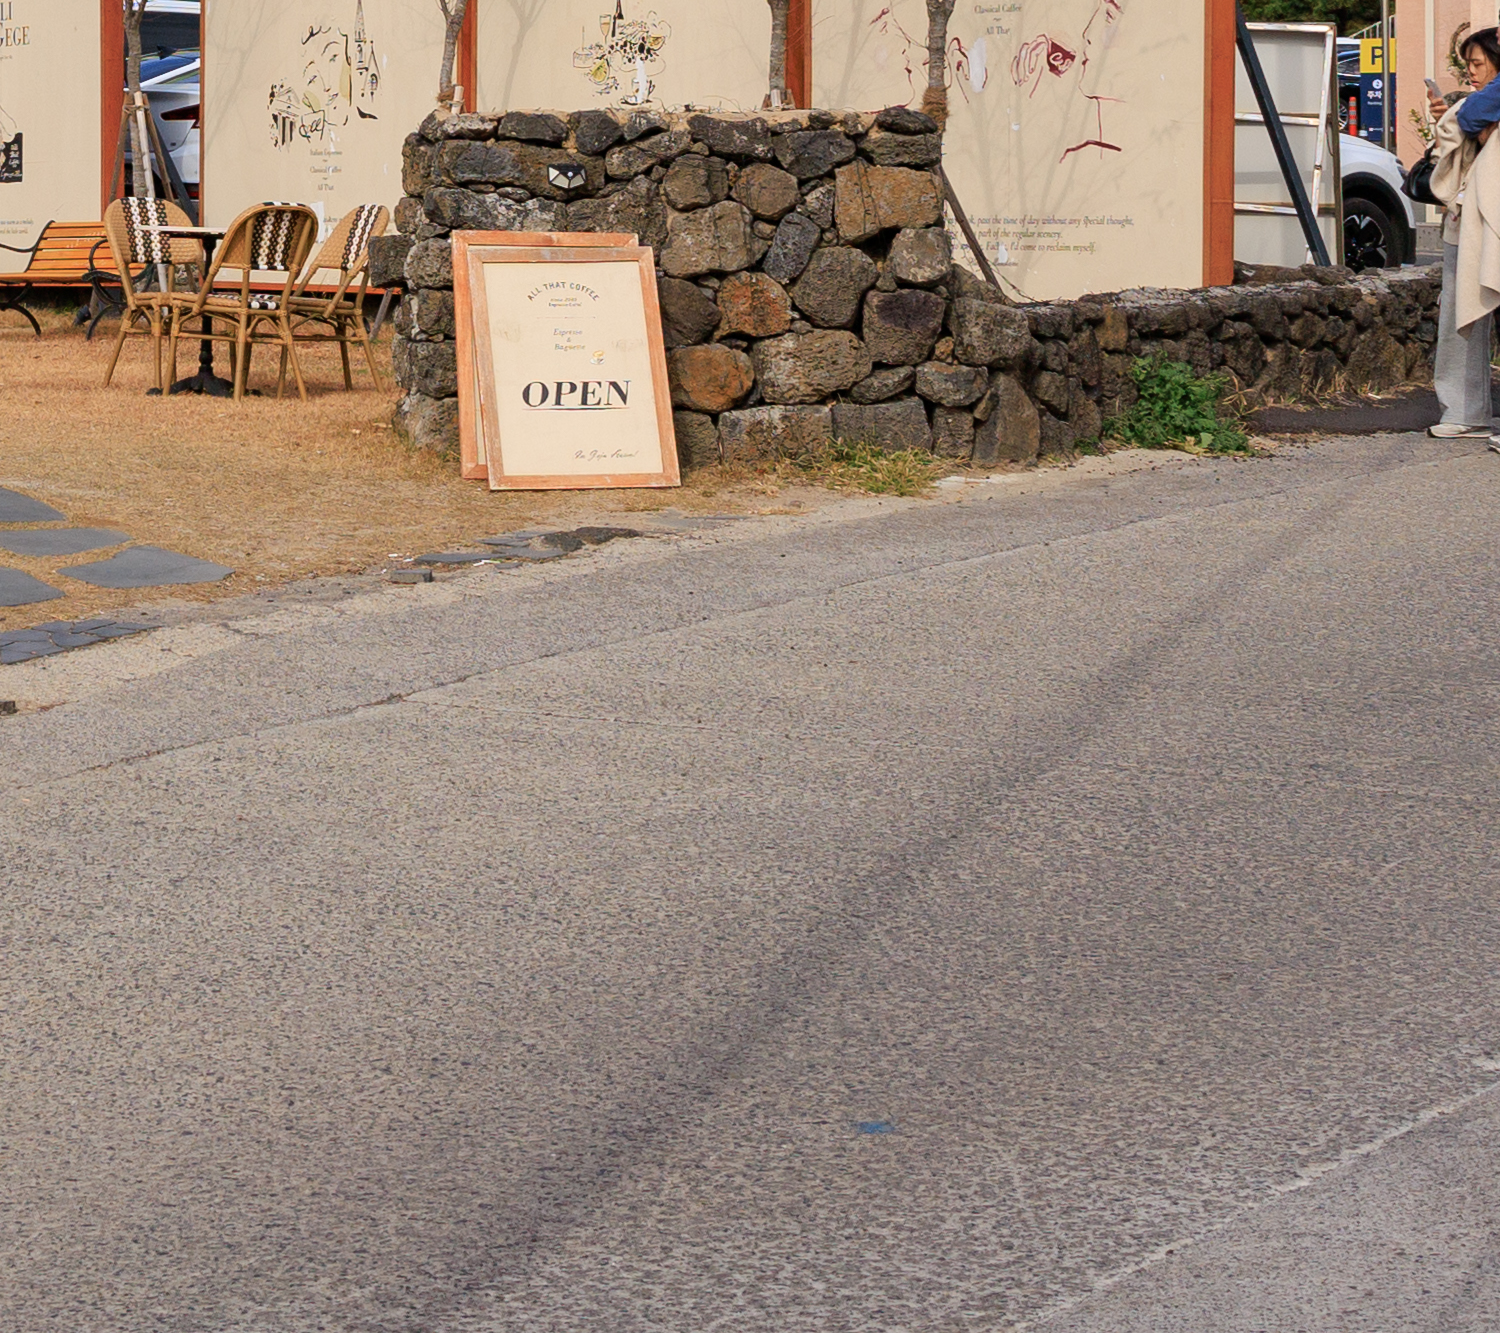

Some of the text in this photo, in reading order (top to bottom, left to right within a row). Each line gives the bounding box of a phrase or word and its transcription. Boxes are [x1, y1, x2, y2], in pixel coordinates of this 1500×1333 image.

[527, 281, 600, 302] ALL THAT COFFEE
[522, 380, 631, 408] OPEN
